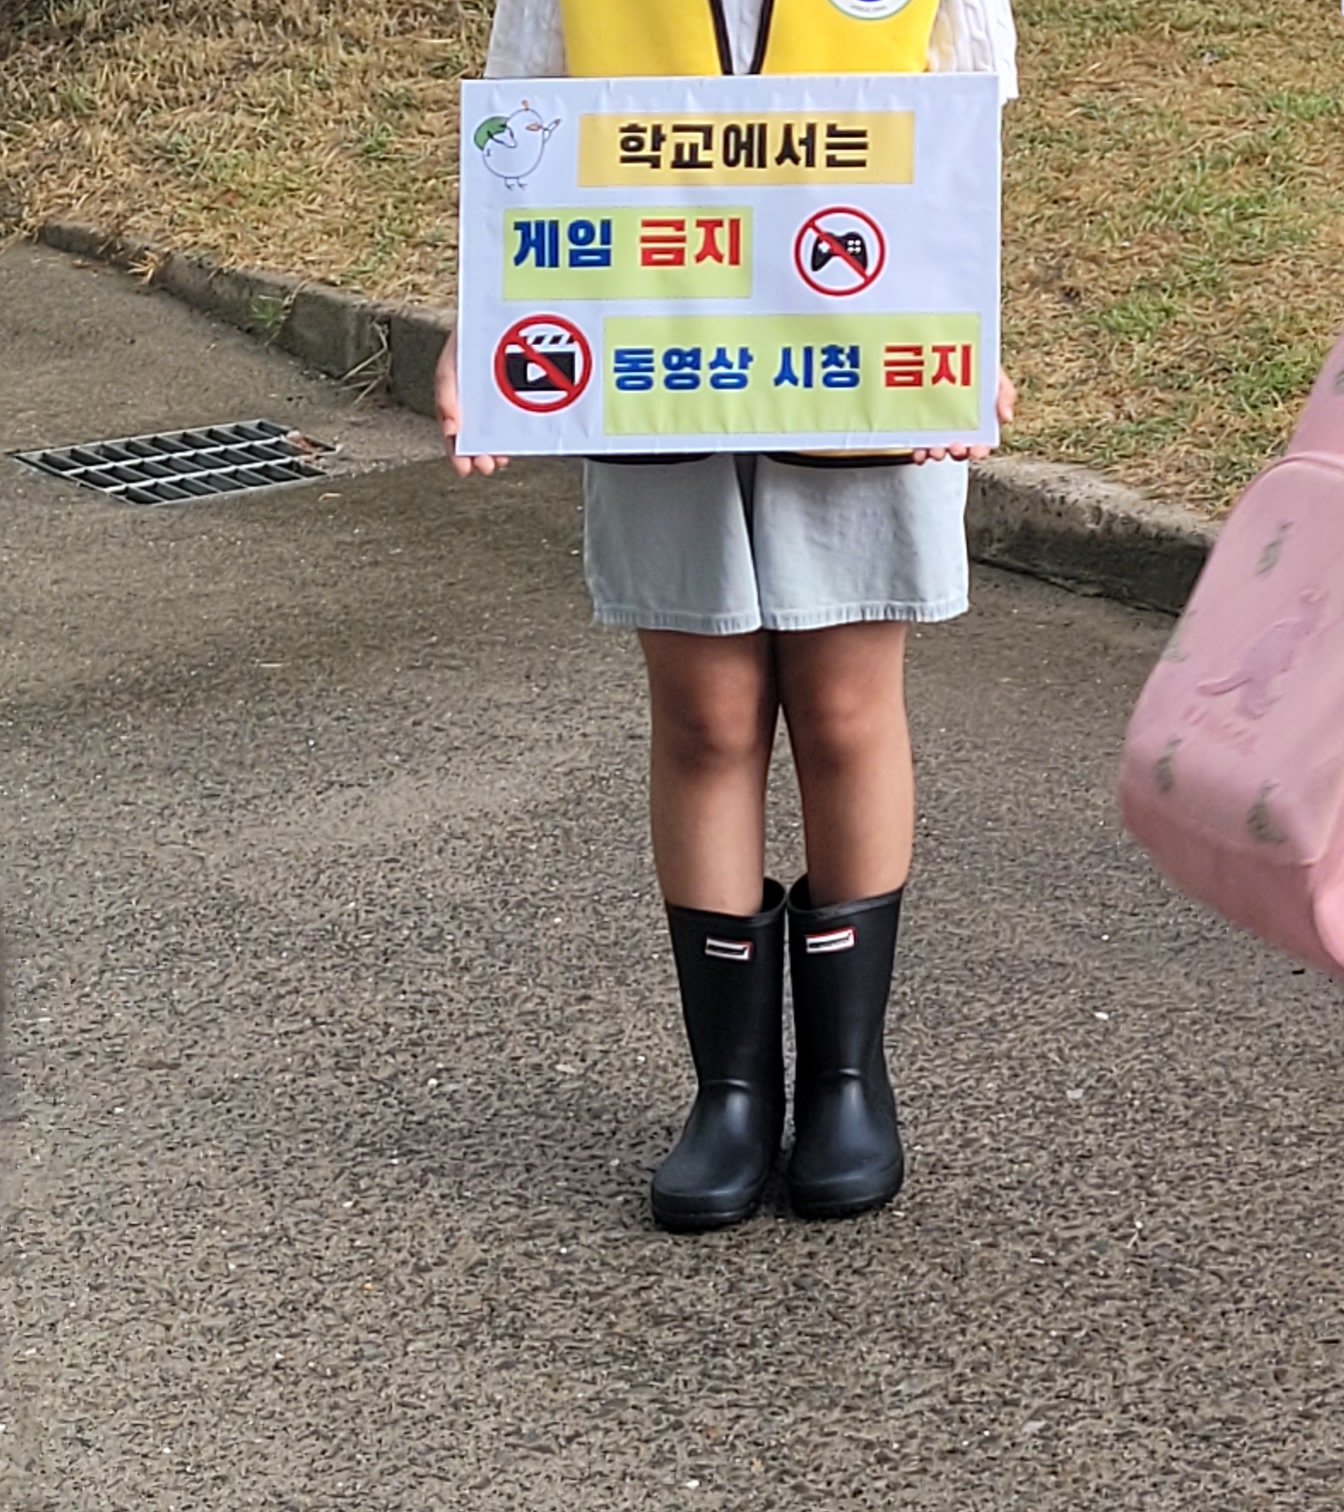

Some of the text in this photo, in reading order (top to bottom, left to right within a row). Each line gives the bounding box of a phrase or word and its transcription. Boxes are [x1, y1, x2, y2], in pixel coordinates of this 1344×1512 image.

[617, 121, 870, 171] 학교에서는
[512, 217, 742, 268] 게임 금지
[612, 342, 973, 391] 동영상 시청 금지
